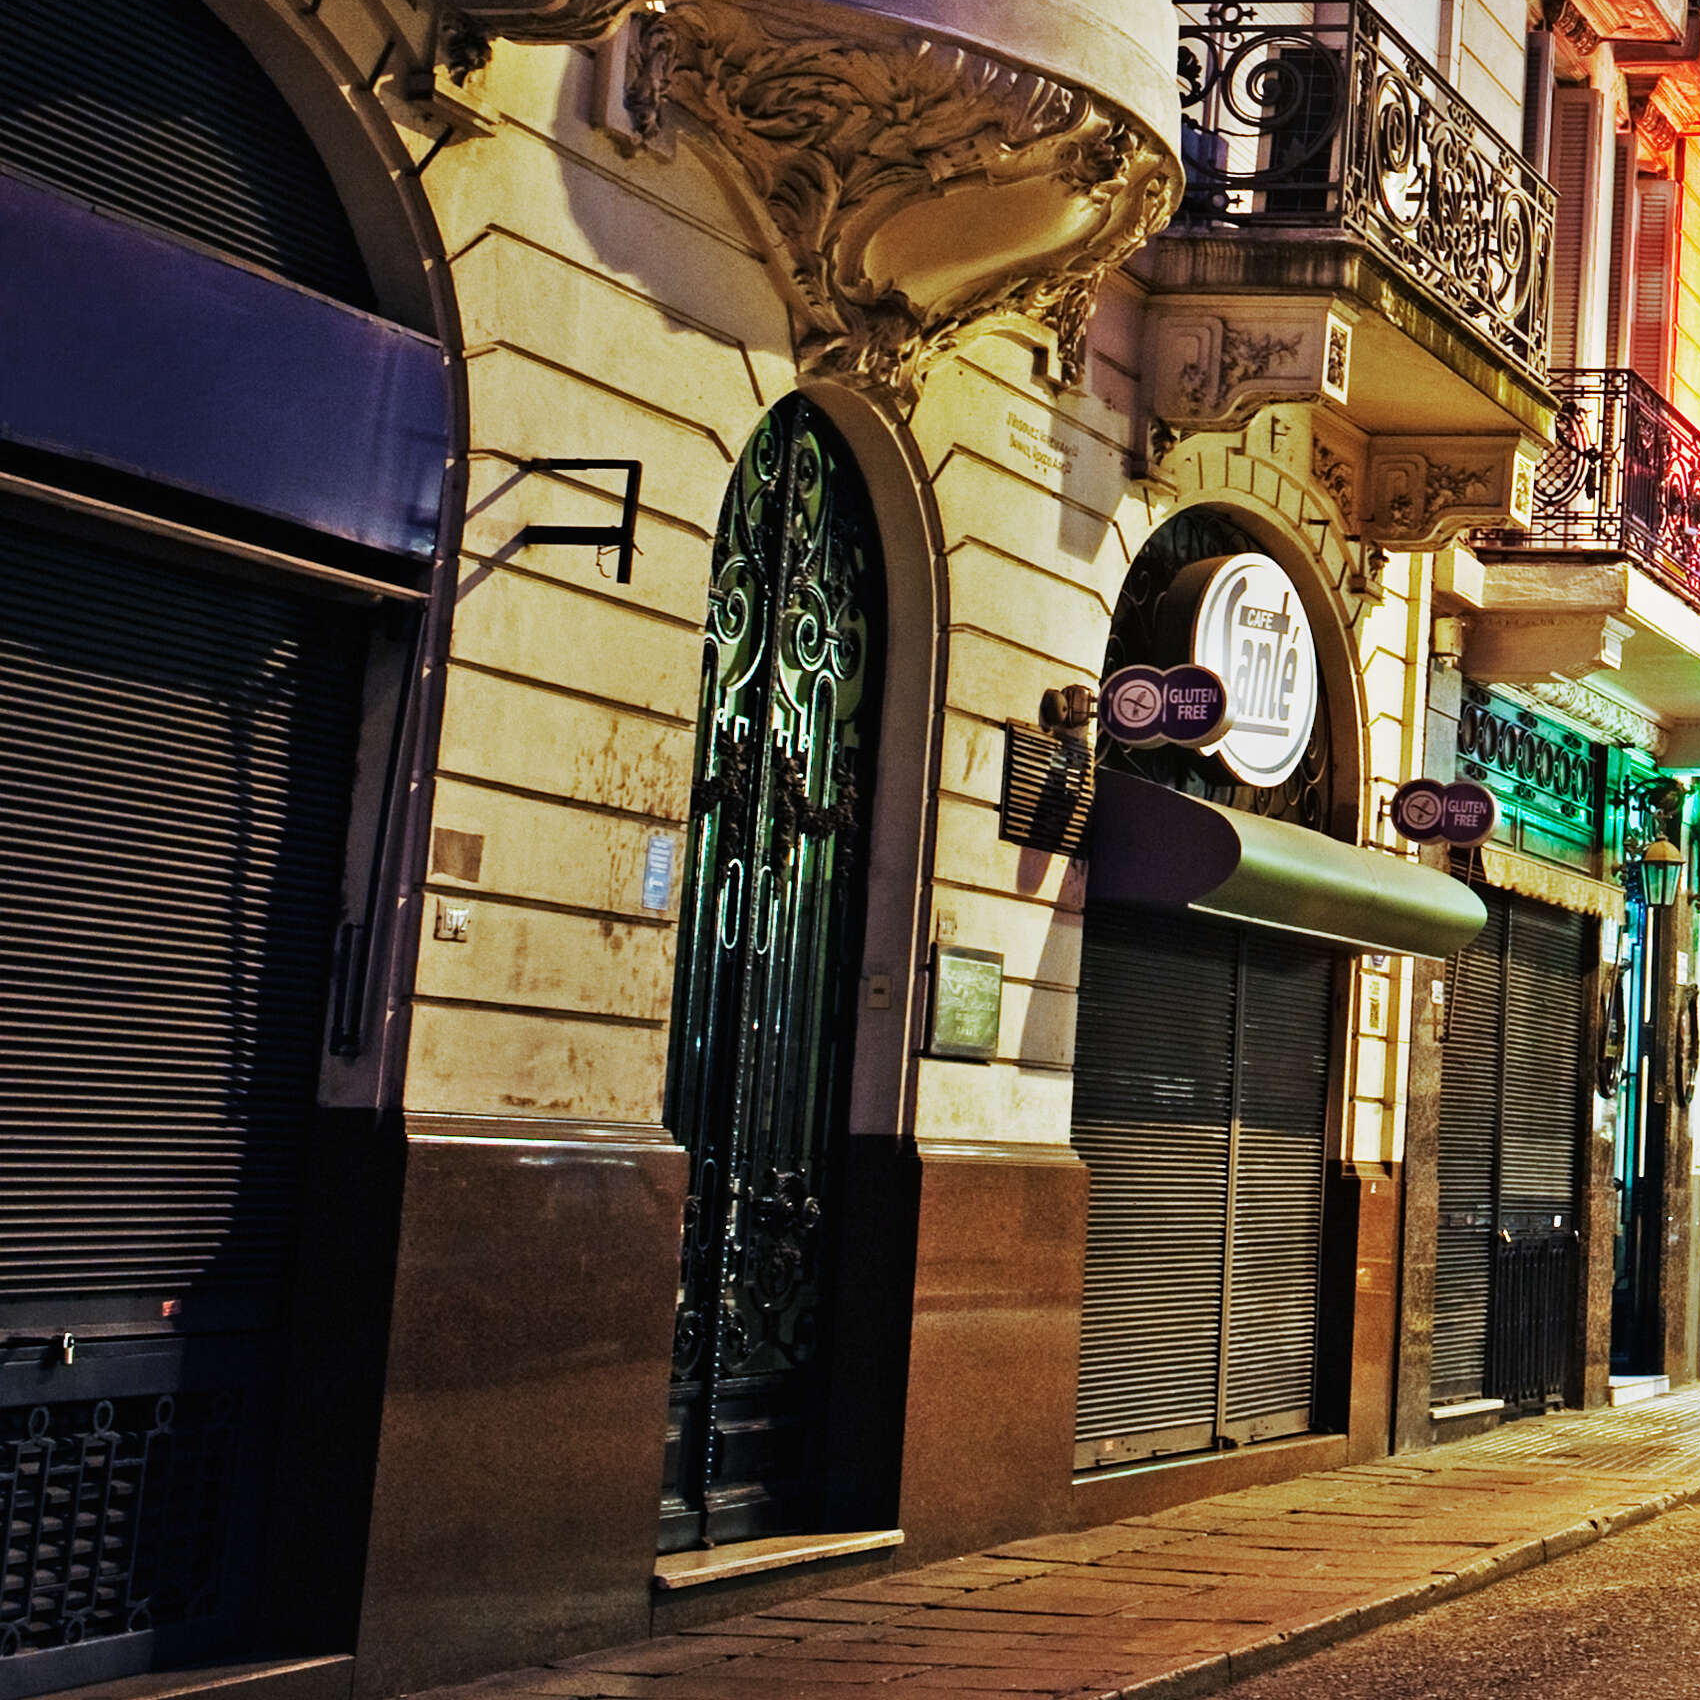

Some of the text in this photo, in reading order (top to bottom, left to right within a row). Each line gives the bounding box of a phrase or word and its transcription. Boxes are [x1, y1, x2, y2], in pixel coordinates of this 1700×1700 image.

[1246, 609, 1274, 629] CAFE
[1221, 576, 1300, 722] Santé
[1168, 687, 1218, 704] GLUTEN
[1177, 704, 1208, 721] FREE
[1447, 800, 1488, 814] GLUTEN
[1453, 814, 1479, 827] FREE
